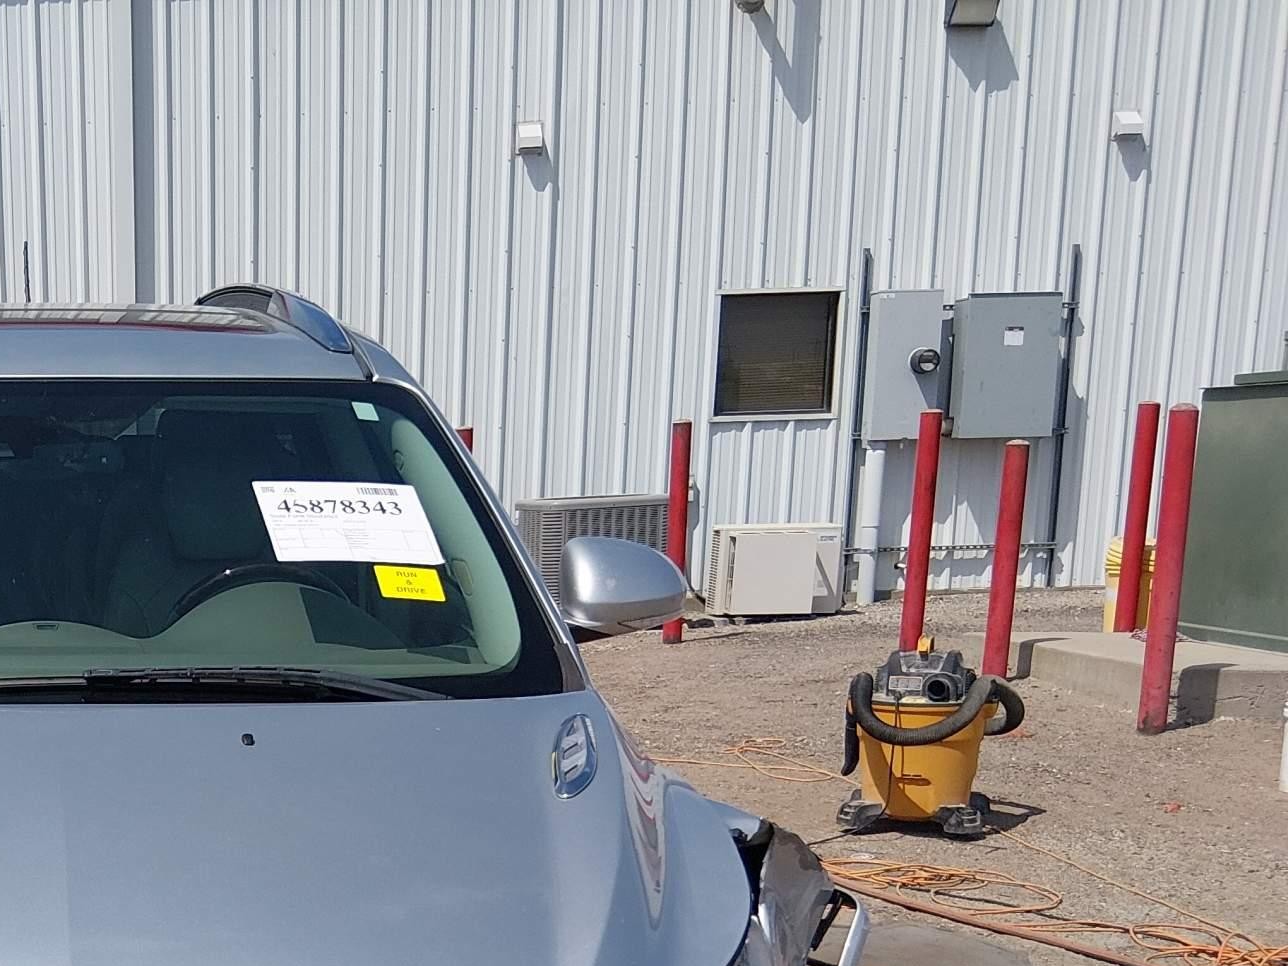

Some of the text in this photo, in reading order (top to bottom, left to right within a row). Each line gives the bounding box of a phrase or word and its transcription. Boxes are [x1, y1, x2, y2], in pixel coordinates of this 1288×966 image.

[277, 499, 403, 516] 45878343
[395, 570, 418, 578] RUN
[396, 586, 426, 595] DRIVE
